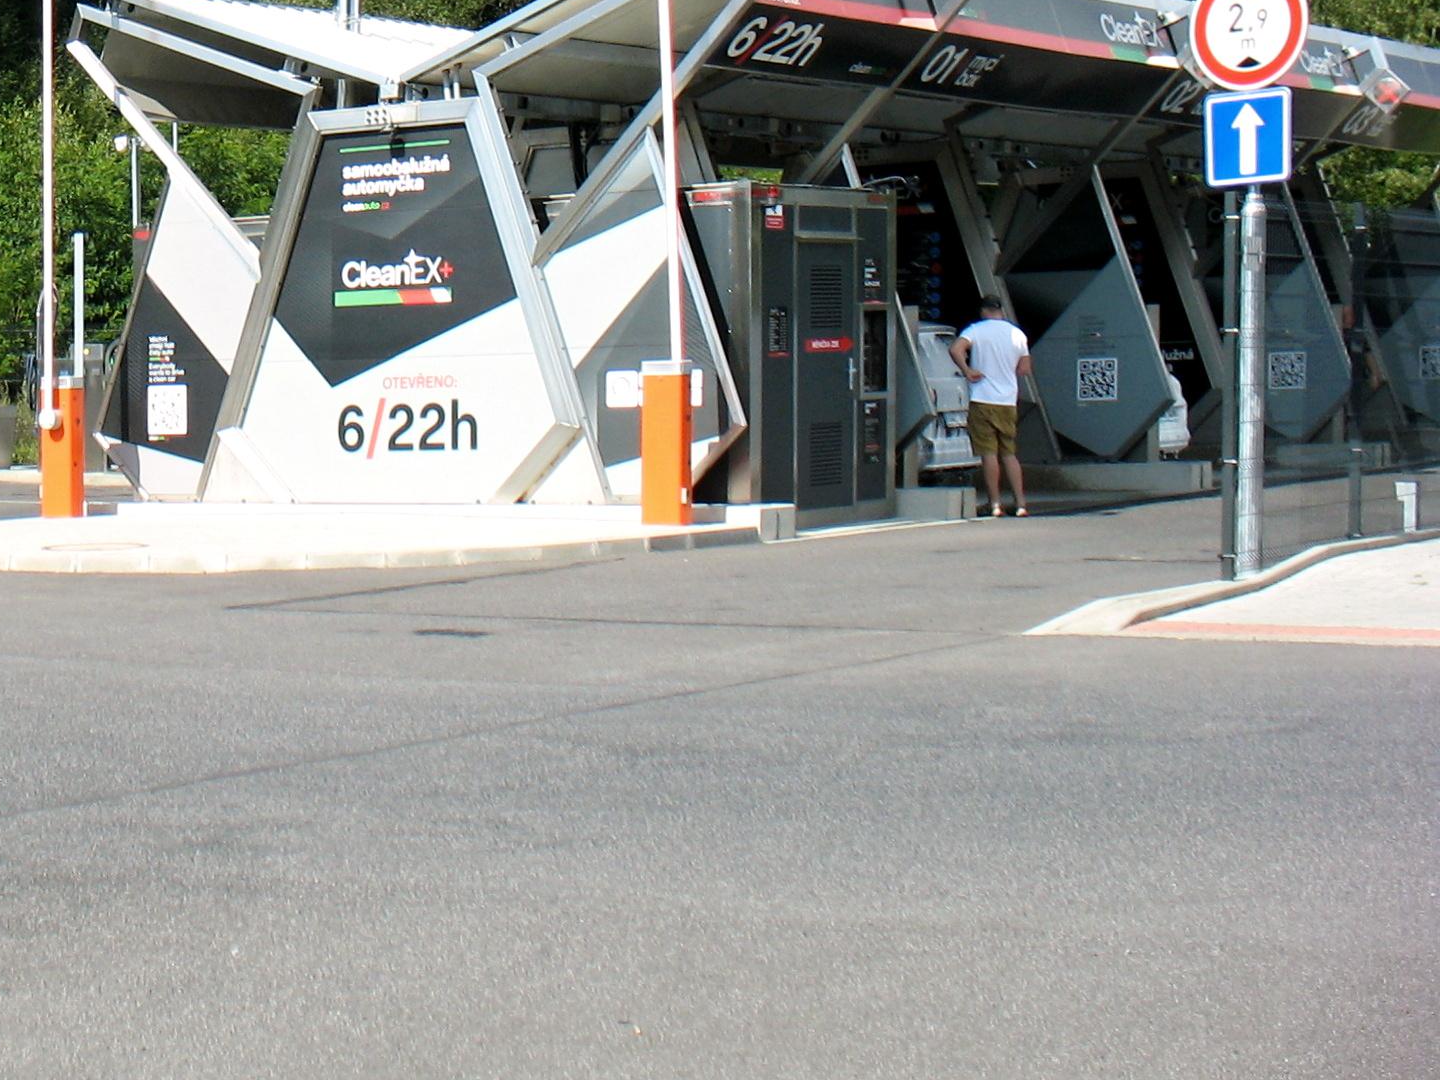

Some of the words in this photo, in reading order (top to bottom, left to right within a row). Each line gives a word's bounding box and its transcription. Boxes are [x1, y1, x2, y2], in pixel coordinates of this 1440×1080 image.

[727, 14, 825, 67] 6/22h
[1241, 37, 1256, 49] m
[920, 44, 969, 84] 01
[342, 174, 425, 197] automyčka
[381, 372, 459, 390] OTEVŘENO:
[338, 397, 478, 460] 6/22h
